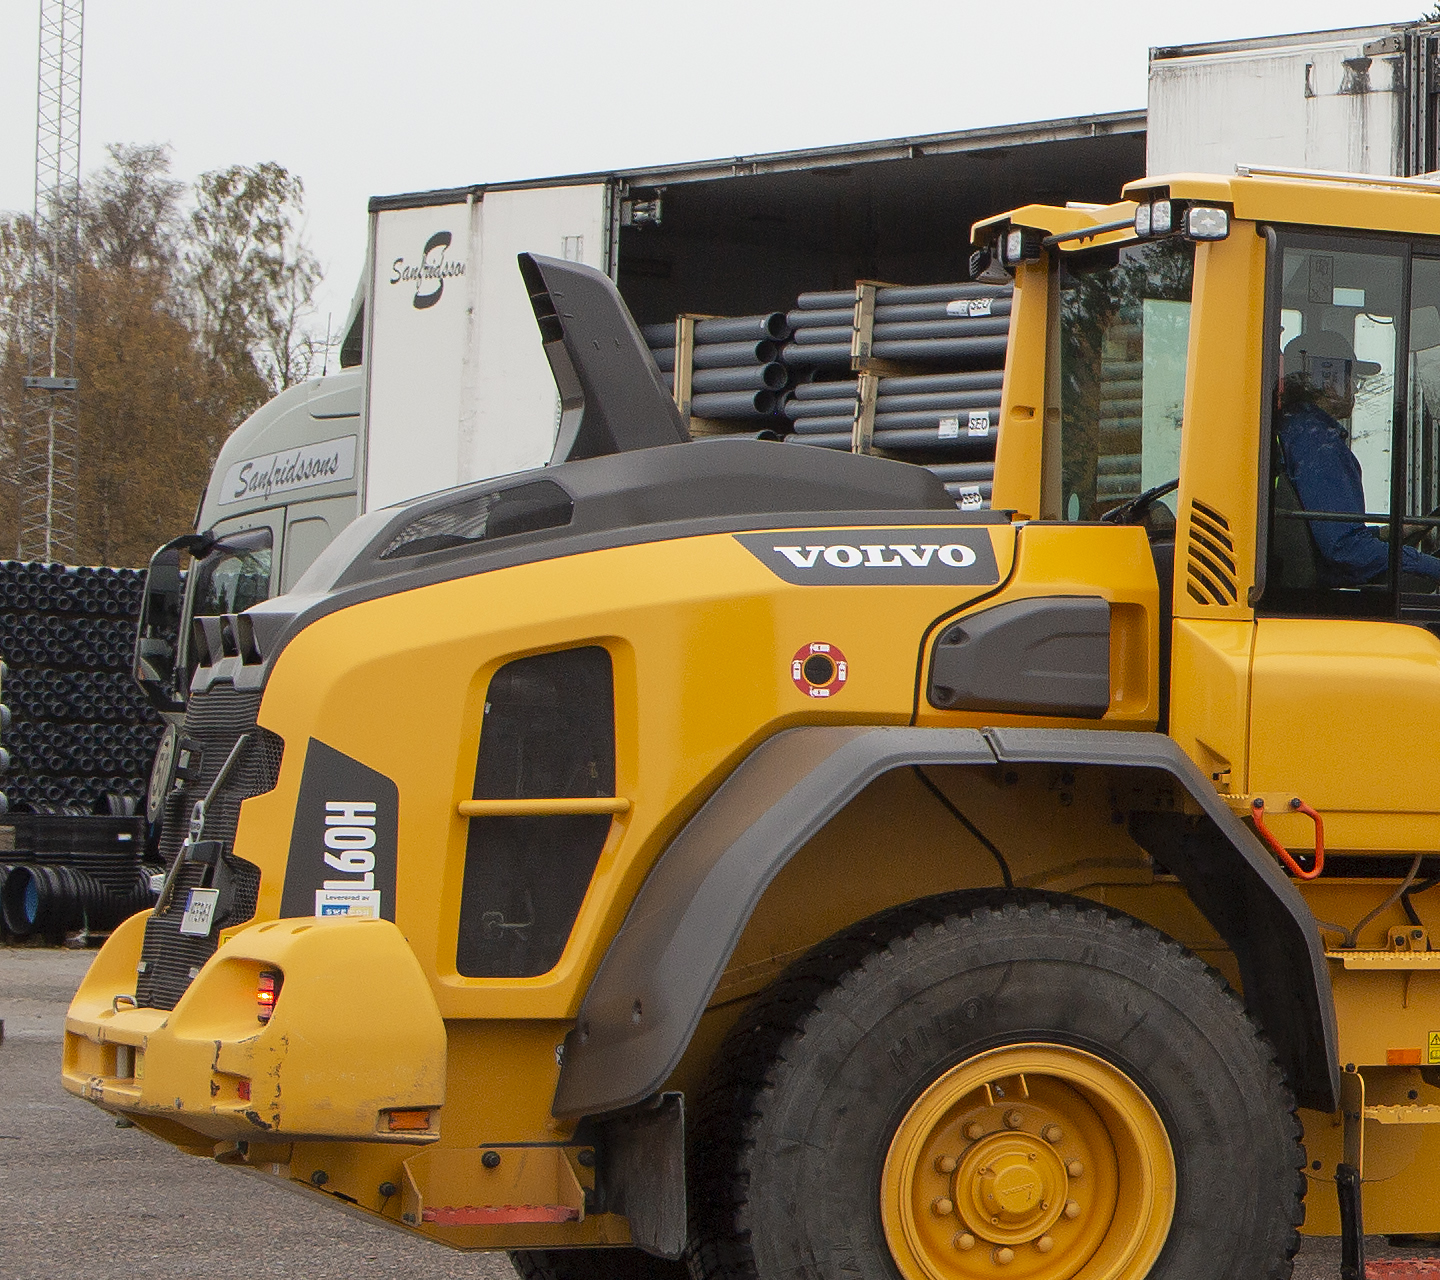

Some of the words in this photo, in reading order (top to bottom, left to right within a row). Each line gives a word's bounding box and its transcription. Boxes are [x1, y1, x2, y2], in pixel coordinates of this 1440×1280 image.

[969, 416, 989, 432] SEO
[234, 450, 340, 501] Sanfridssons
[773, 544, 977, 568] VOLVO
[323, 801, 377, 890] L60H
